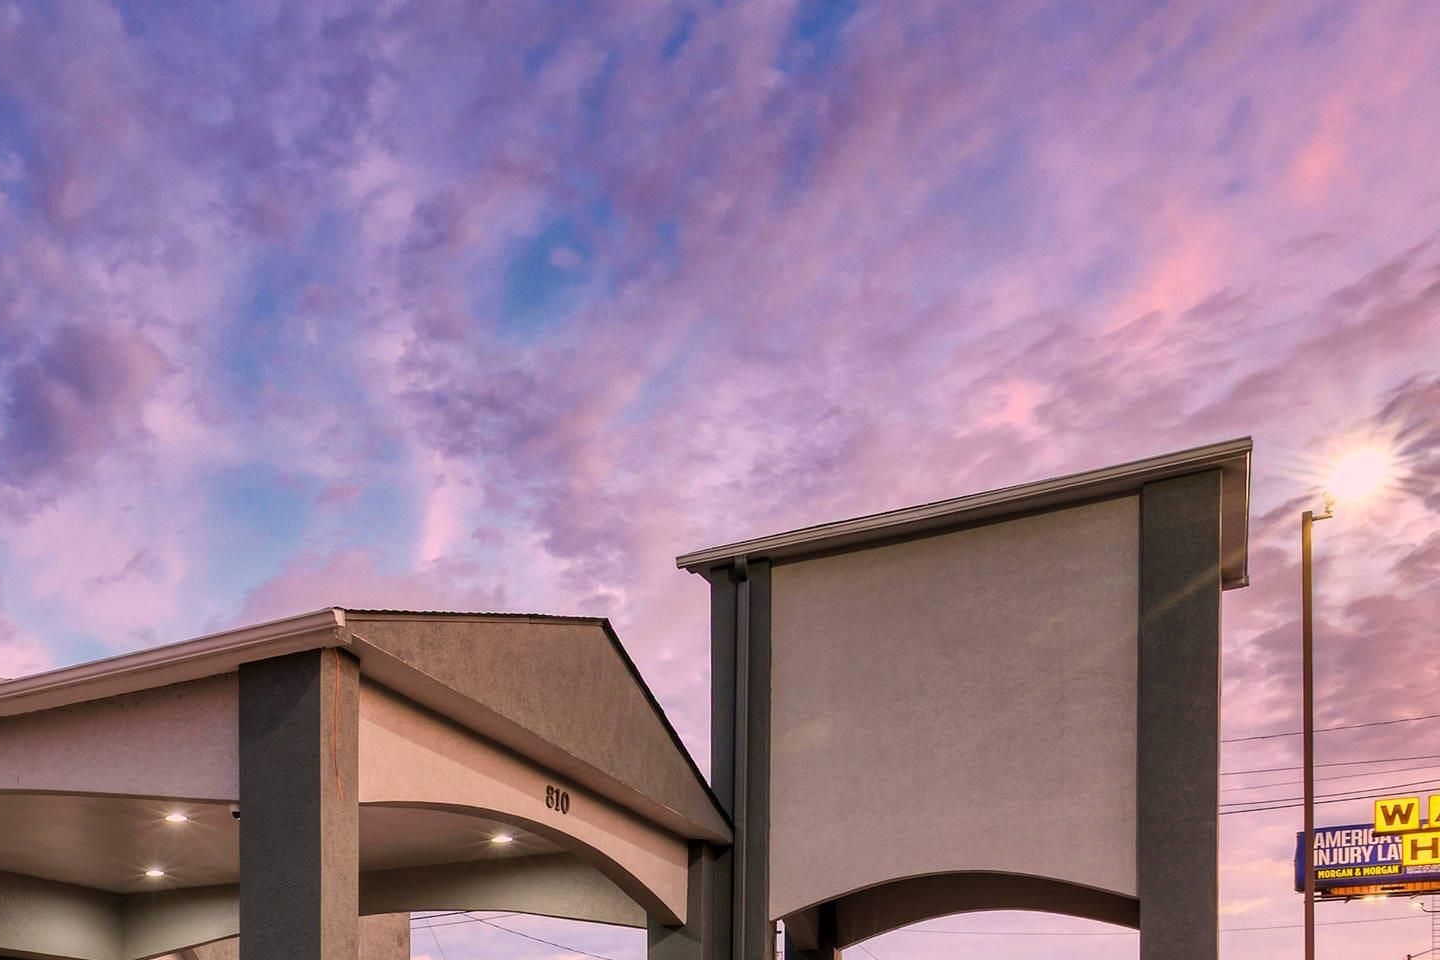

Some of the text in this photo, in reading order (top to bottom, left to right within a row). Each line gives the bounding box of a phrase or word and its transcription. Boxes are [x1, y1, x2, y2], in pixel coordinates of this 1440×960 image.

[546, 785, 569, 814] 810
[1314, 846, 1373, 866] INJURY
[1318, 868, 1353, 879] MORGAN
[1355, 867, 1361, 876] &
[1363, 865, 1399, 877] MORGAN
